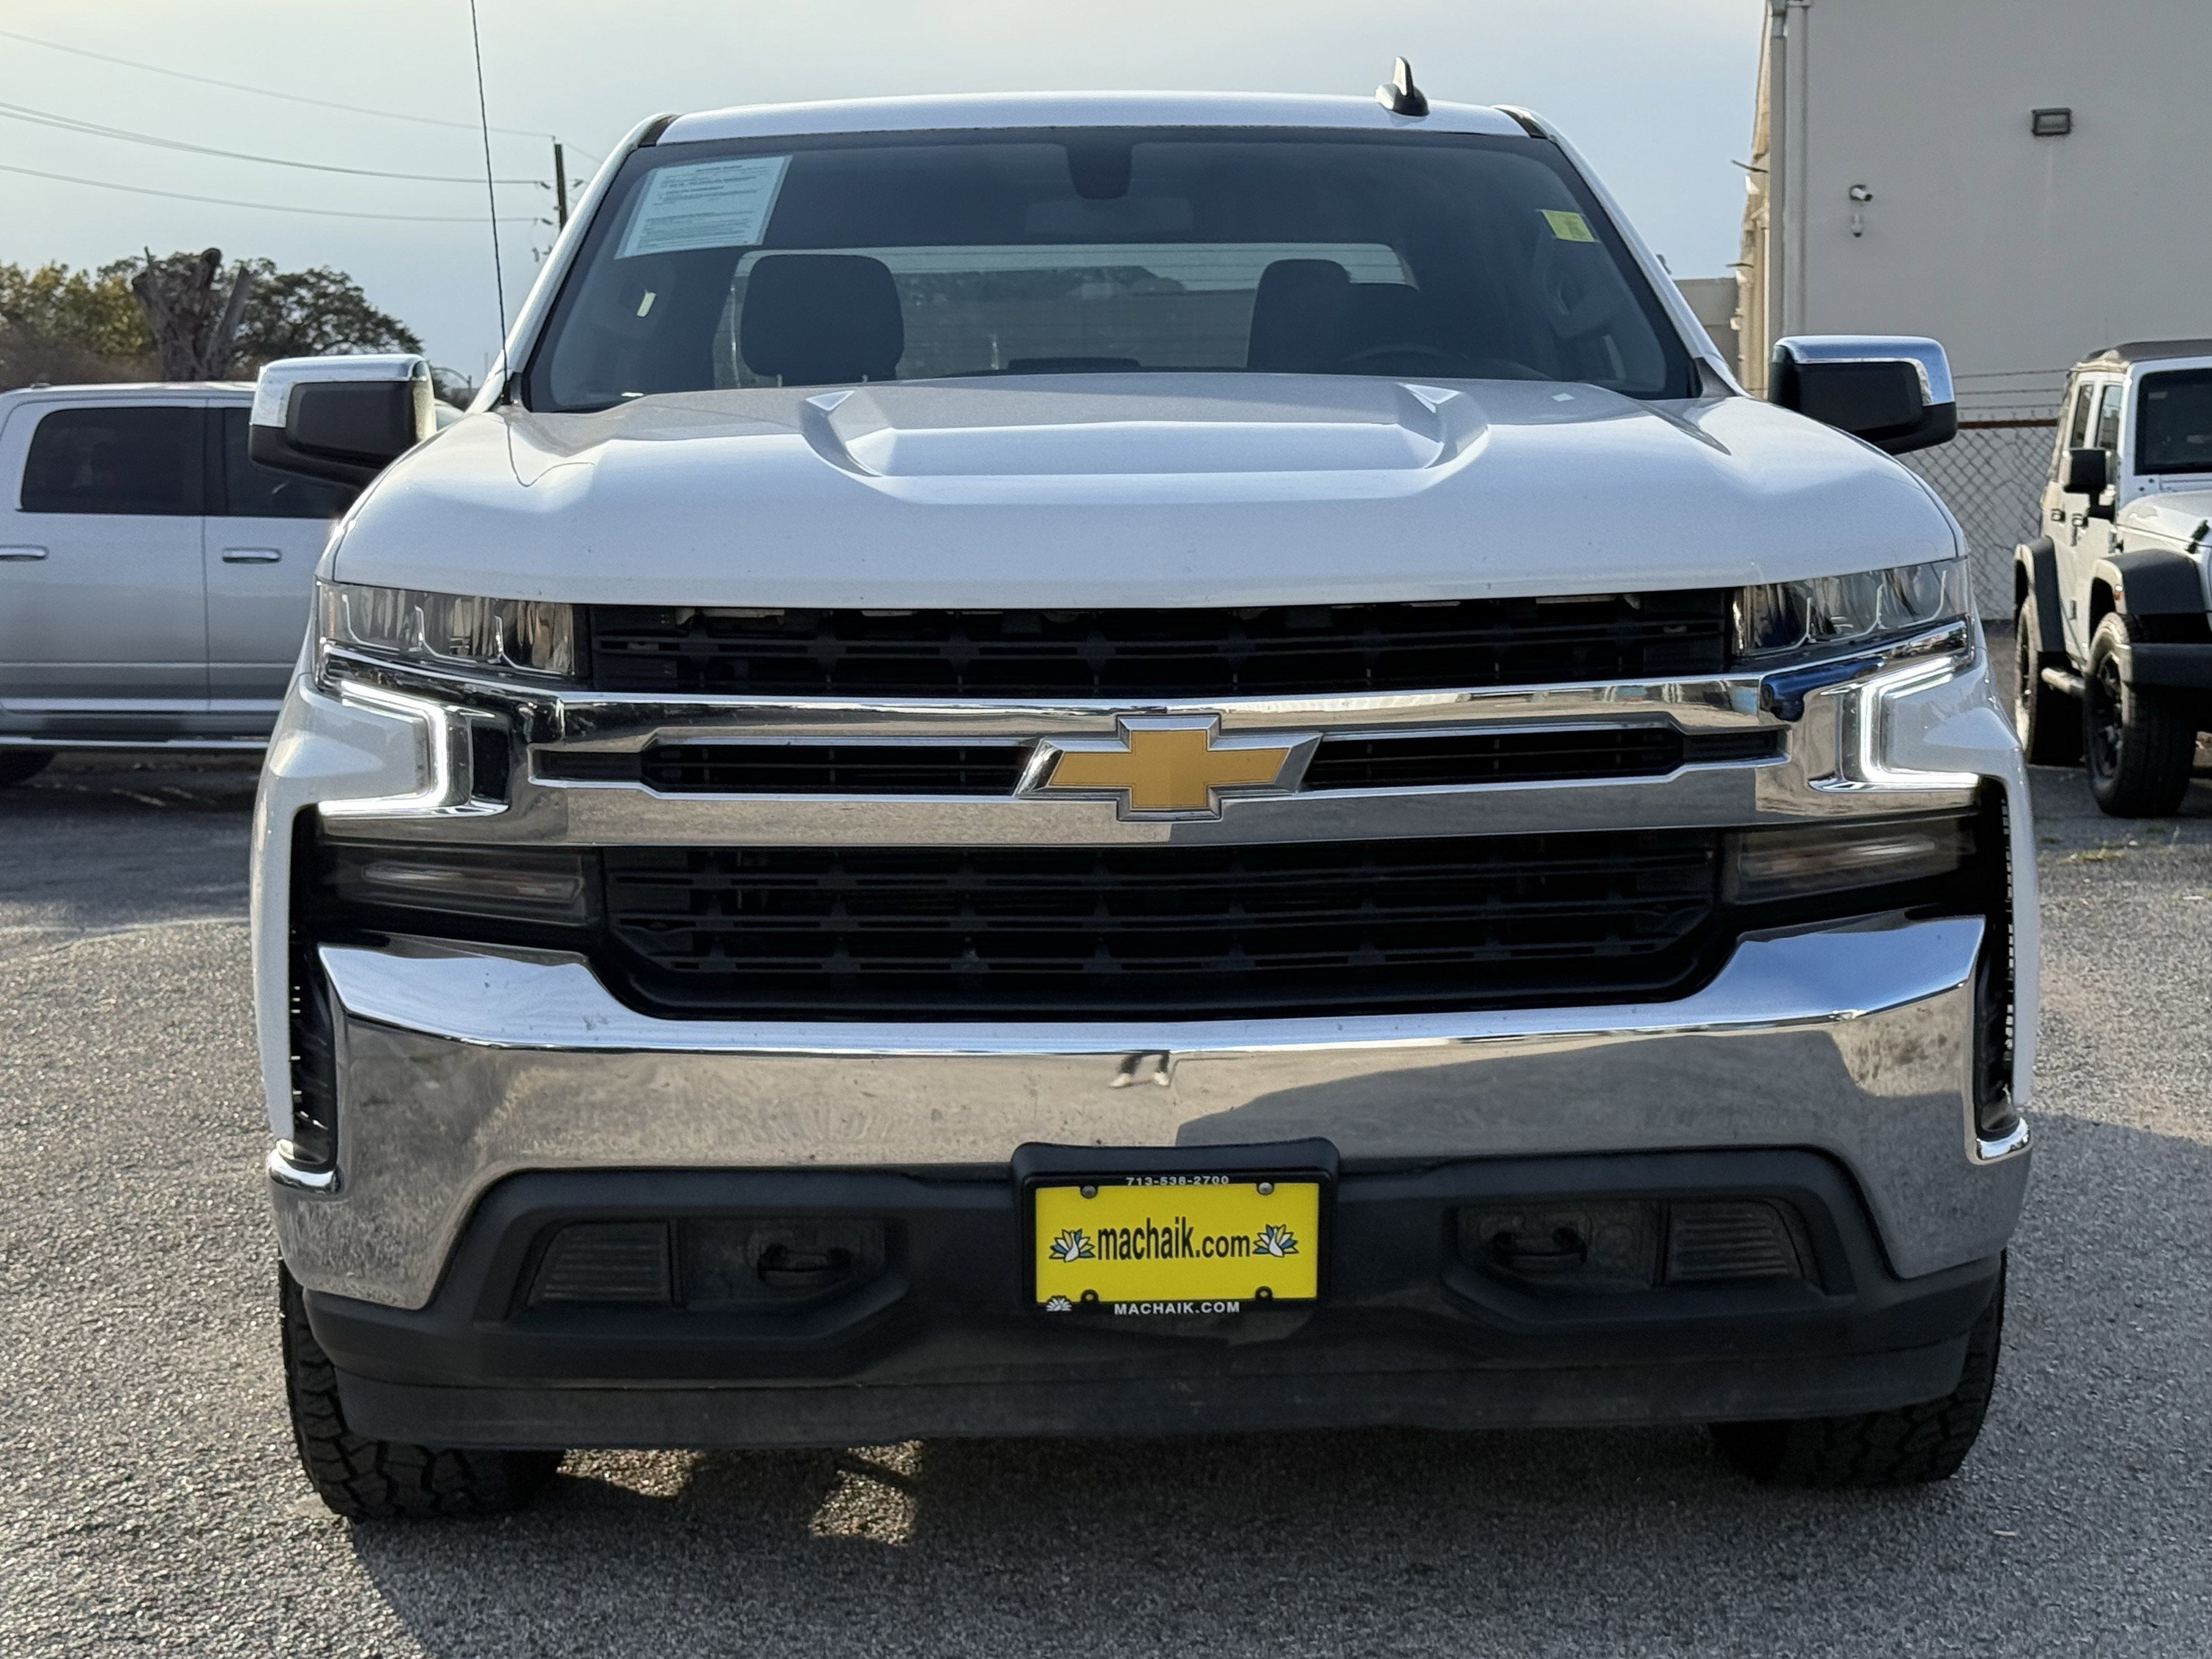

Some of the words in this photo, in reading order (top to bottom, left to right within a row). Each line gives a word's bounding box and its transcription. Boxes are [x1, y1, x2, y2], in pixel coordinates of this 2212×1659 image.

[1126, 1176, 1229, 1186] 713-538-2700
[1098, 1216, 1251, 1260] machaik.com
[1114, 1302, 1240, 1315] MACHAIK.COM
